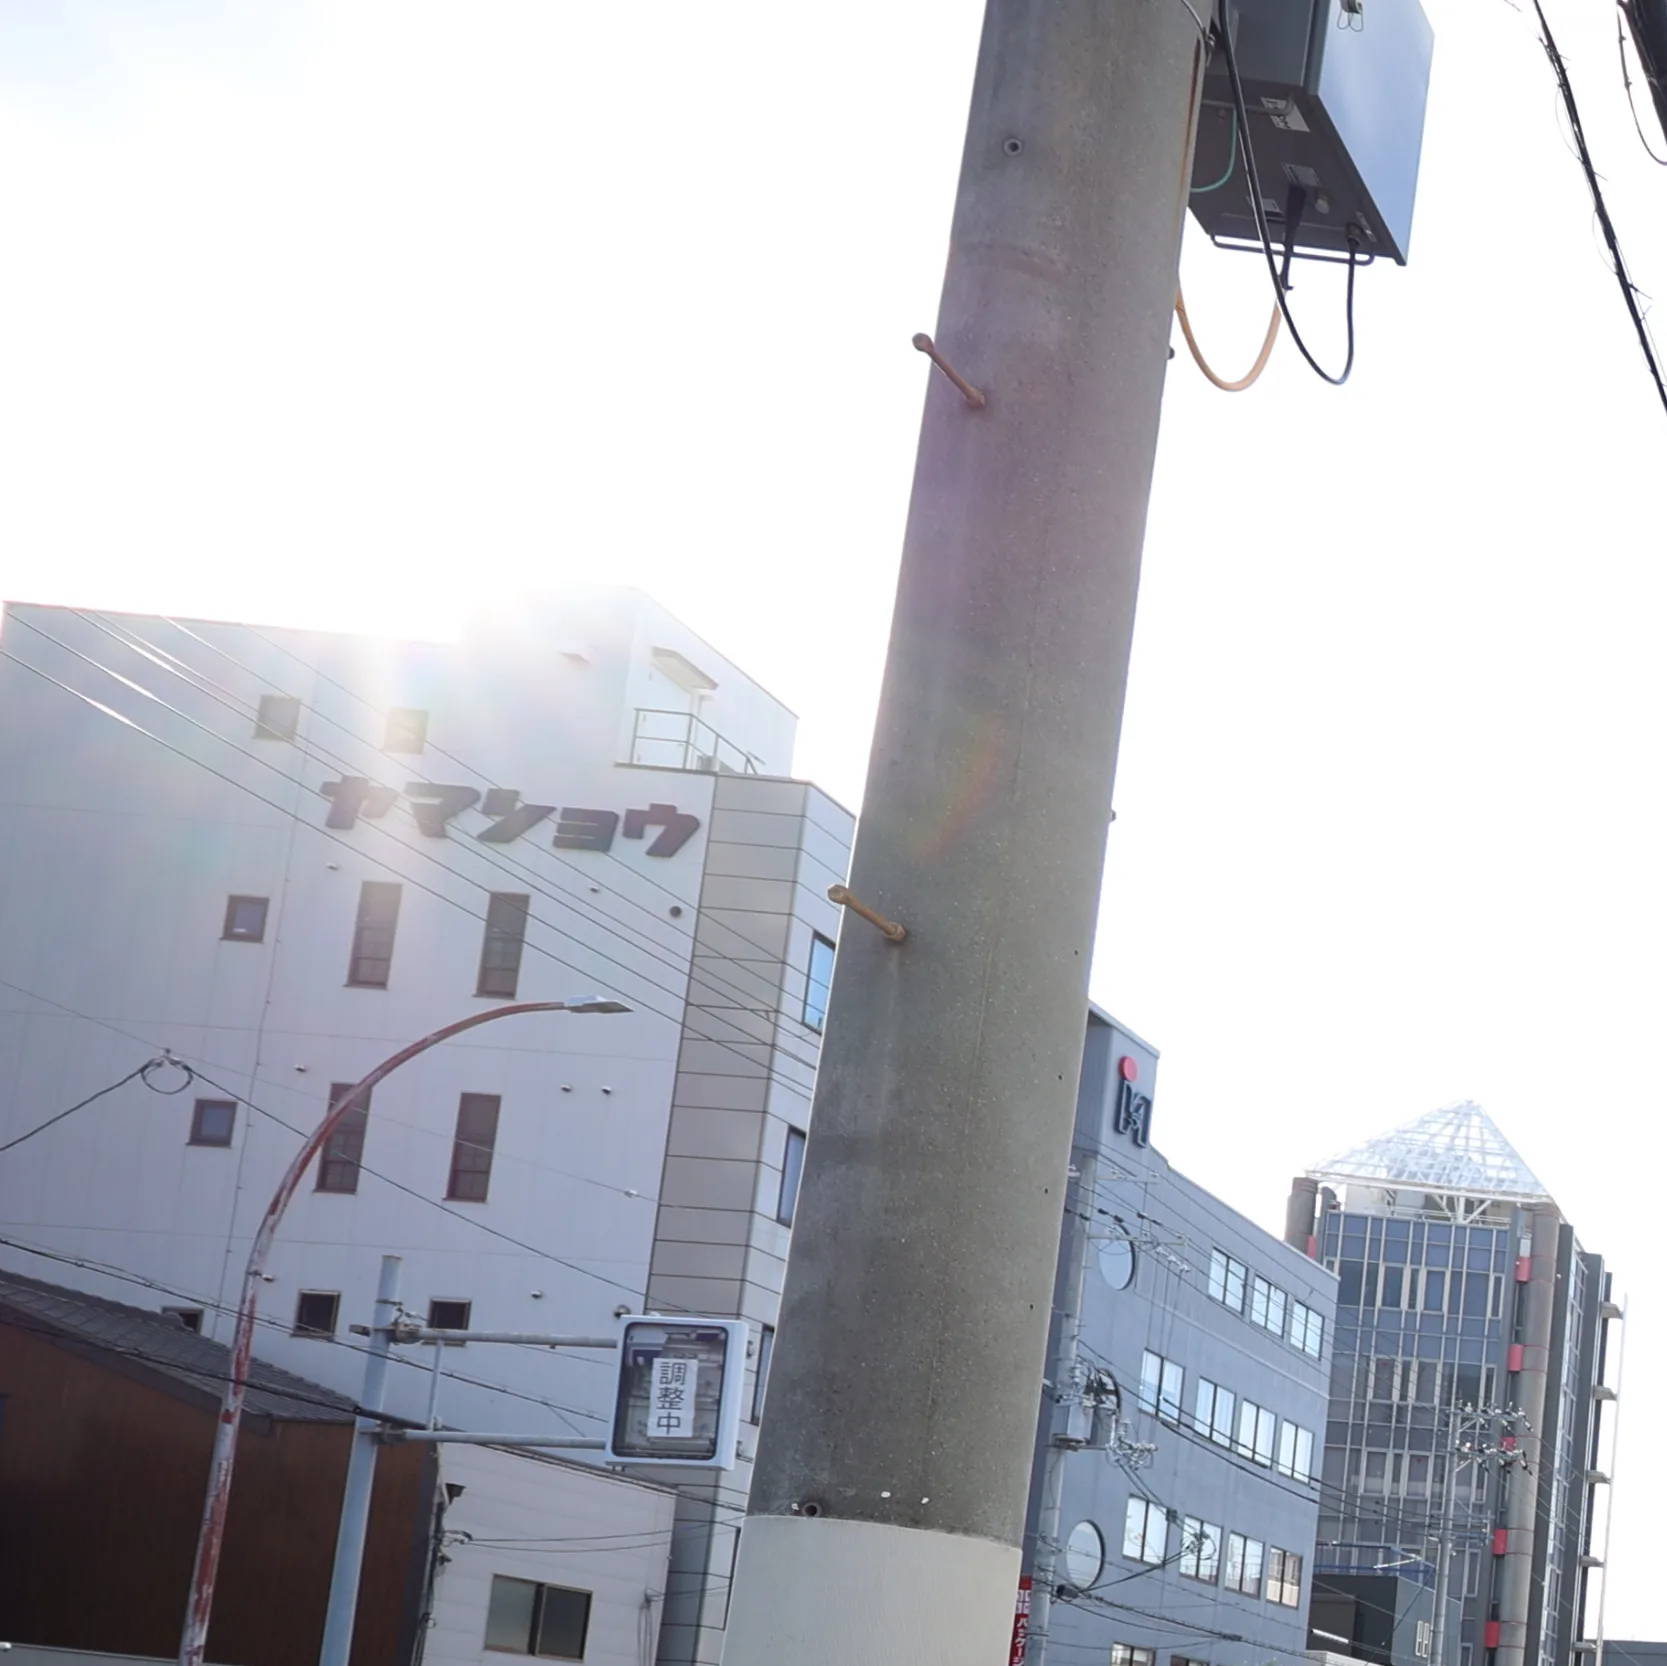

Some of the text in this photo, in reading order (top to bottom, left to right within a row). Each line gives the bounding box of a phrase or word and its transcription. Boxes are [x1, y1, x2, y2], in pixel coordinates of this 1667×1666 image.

[320, 774, 700, 858] ヤマショウ
[656, 1361, 687, 1435] 調整中
